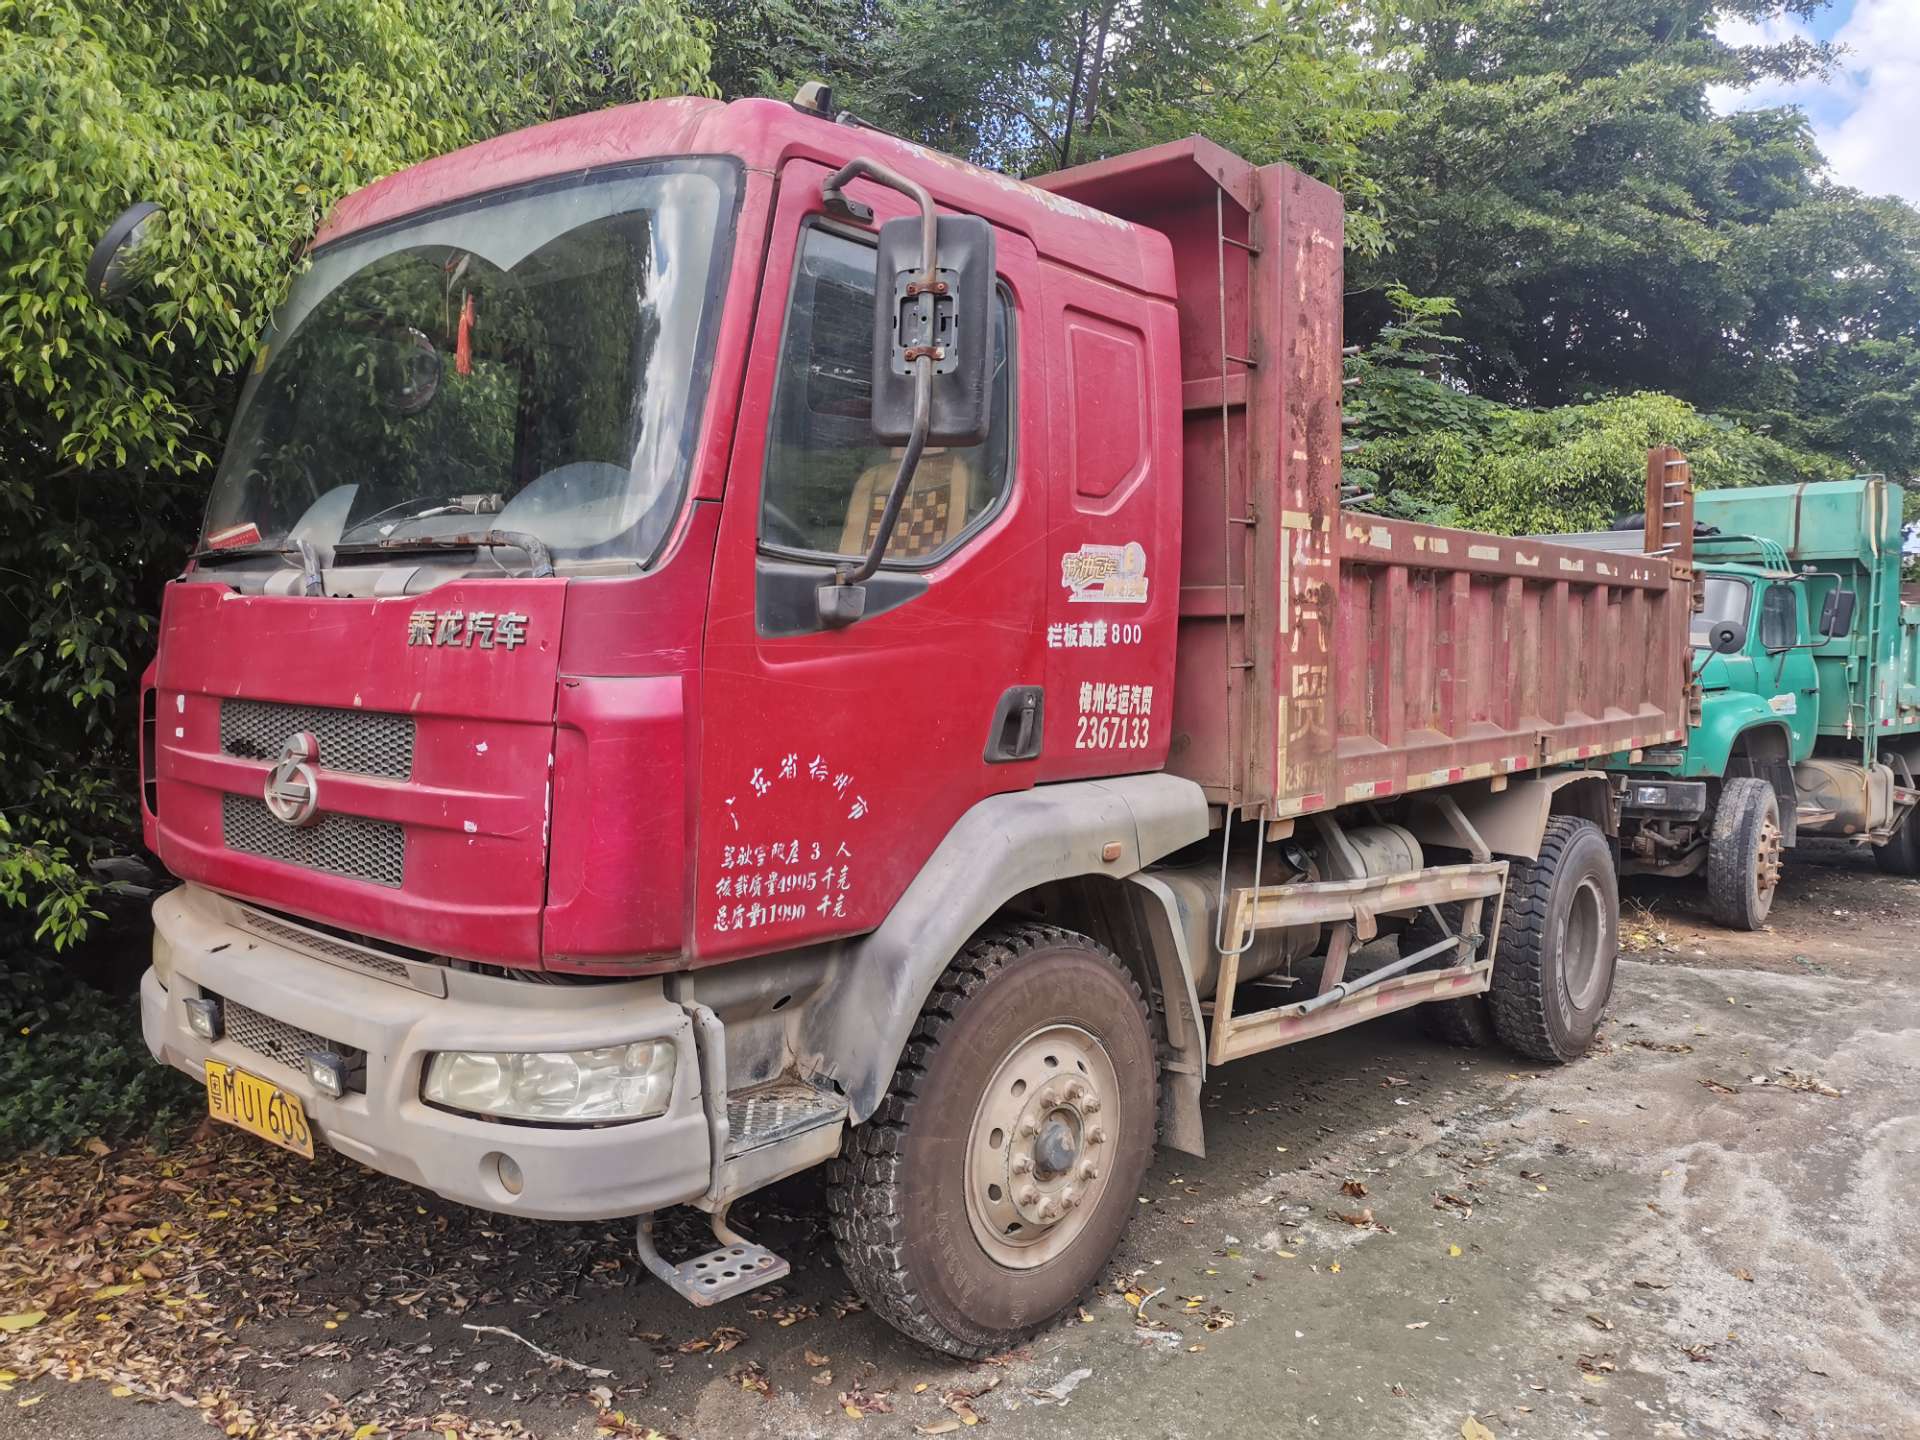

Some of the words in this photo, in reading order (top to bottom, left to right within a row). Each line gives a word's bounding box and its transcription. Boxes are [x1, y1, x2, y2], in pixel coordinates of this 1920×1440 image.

[407, 609, 529, 651] 乘龙汽车
[1047, 619, 1108, 648] 栏板高度
[1111, 623, 1142, 644] 800
[1078, 681, 1153, 715] 梅州华运汽贸
[1075, 715, 1150, 749] 2367133
[810, 842, 821, 860] 3
[836, 841, 852, 857] 人
